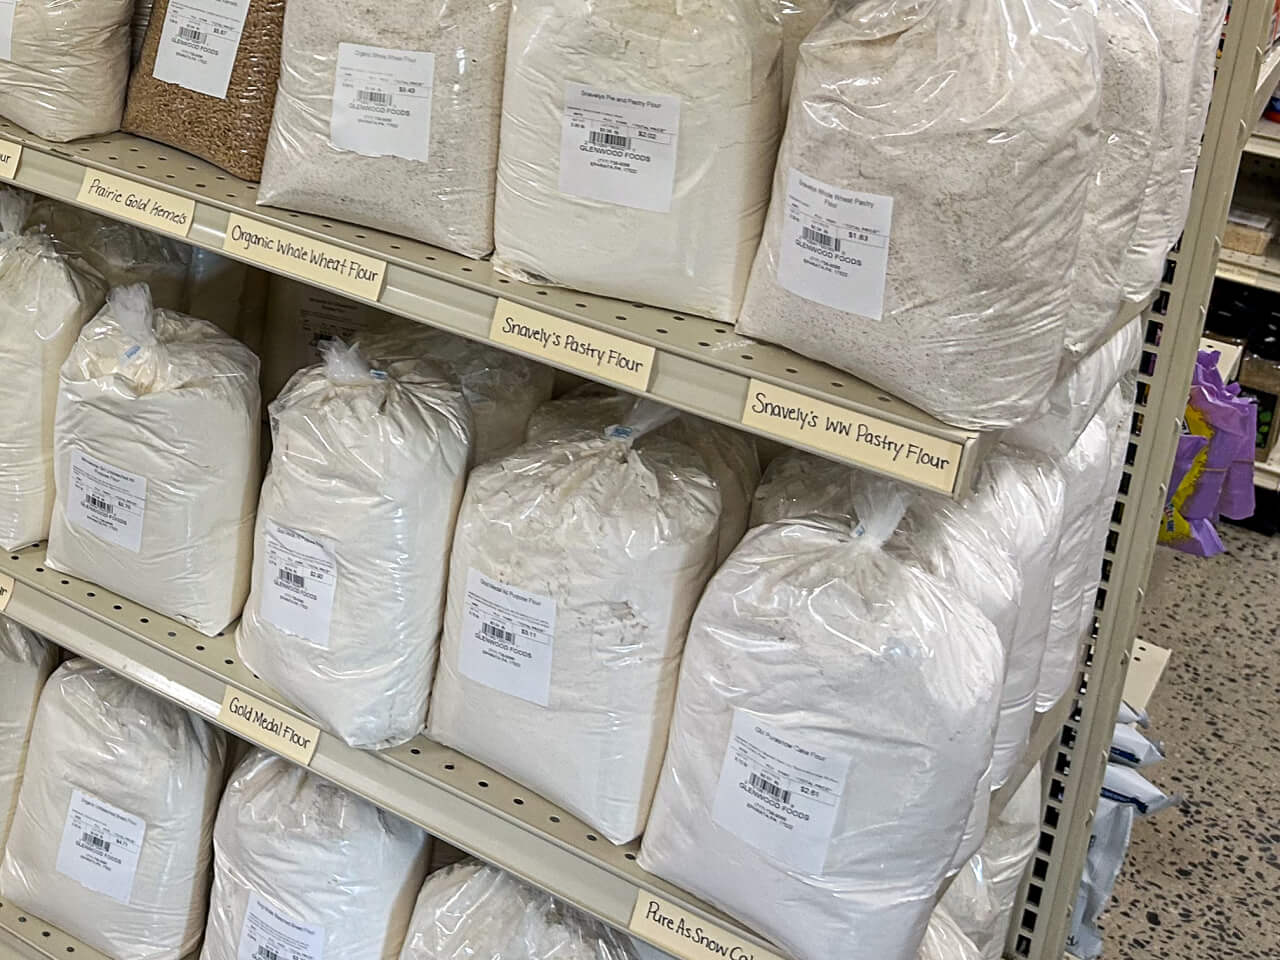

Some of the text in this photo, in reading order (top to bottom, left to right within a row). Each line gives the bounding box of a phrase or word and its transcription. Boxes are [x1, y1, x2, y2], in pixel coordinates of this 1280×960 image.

[579, 144, 651, 163] GLENWOOD FOODS
[87, 178, 187, 228] Prairie Gold Kernels
[231, 224, 378, 283] Organic Whole Wheat Flour
[795, 238, 834, 259] GLENWOOD
[834, 251, 863, 267] FOODS
[502, 317, 644, 374] Snavely's Pastry Flour
[752, 393, 950, 472] Snavely's WW Pastry Flour
[229, 696, 312, 749] Gold Medal Flour
[738, 781, 811, 822] GLENWOOD FOODS
[645, 900, 675, 932] Pure
[675, 916, 692, 938] As
[691, 926, 727, 956] Snow
